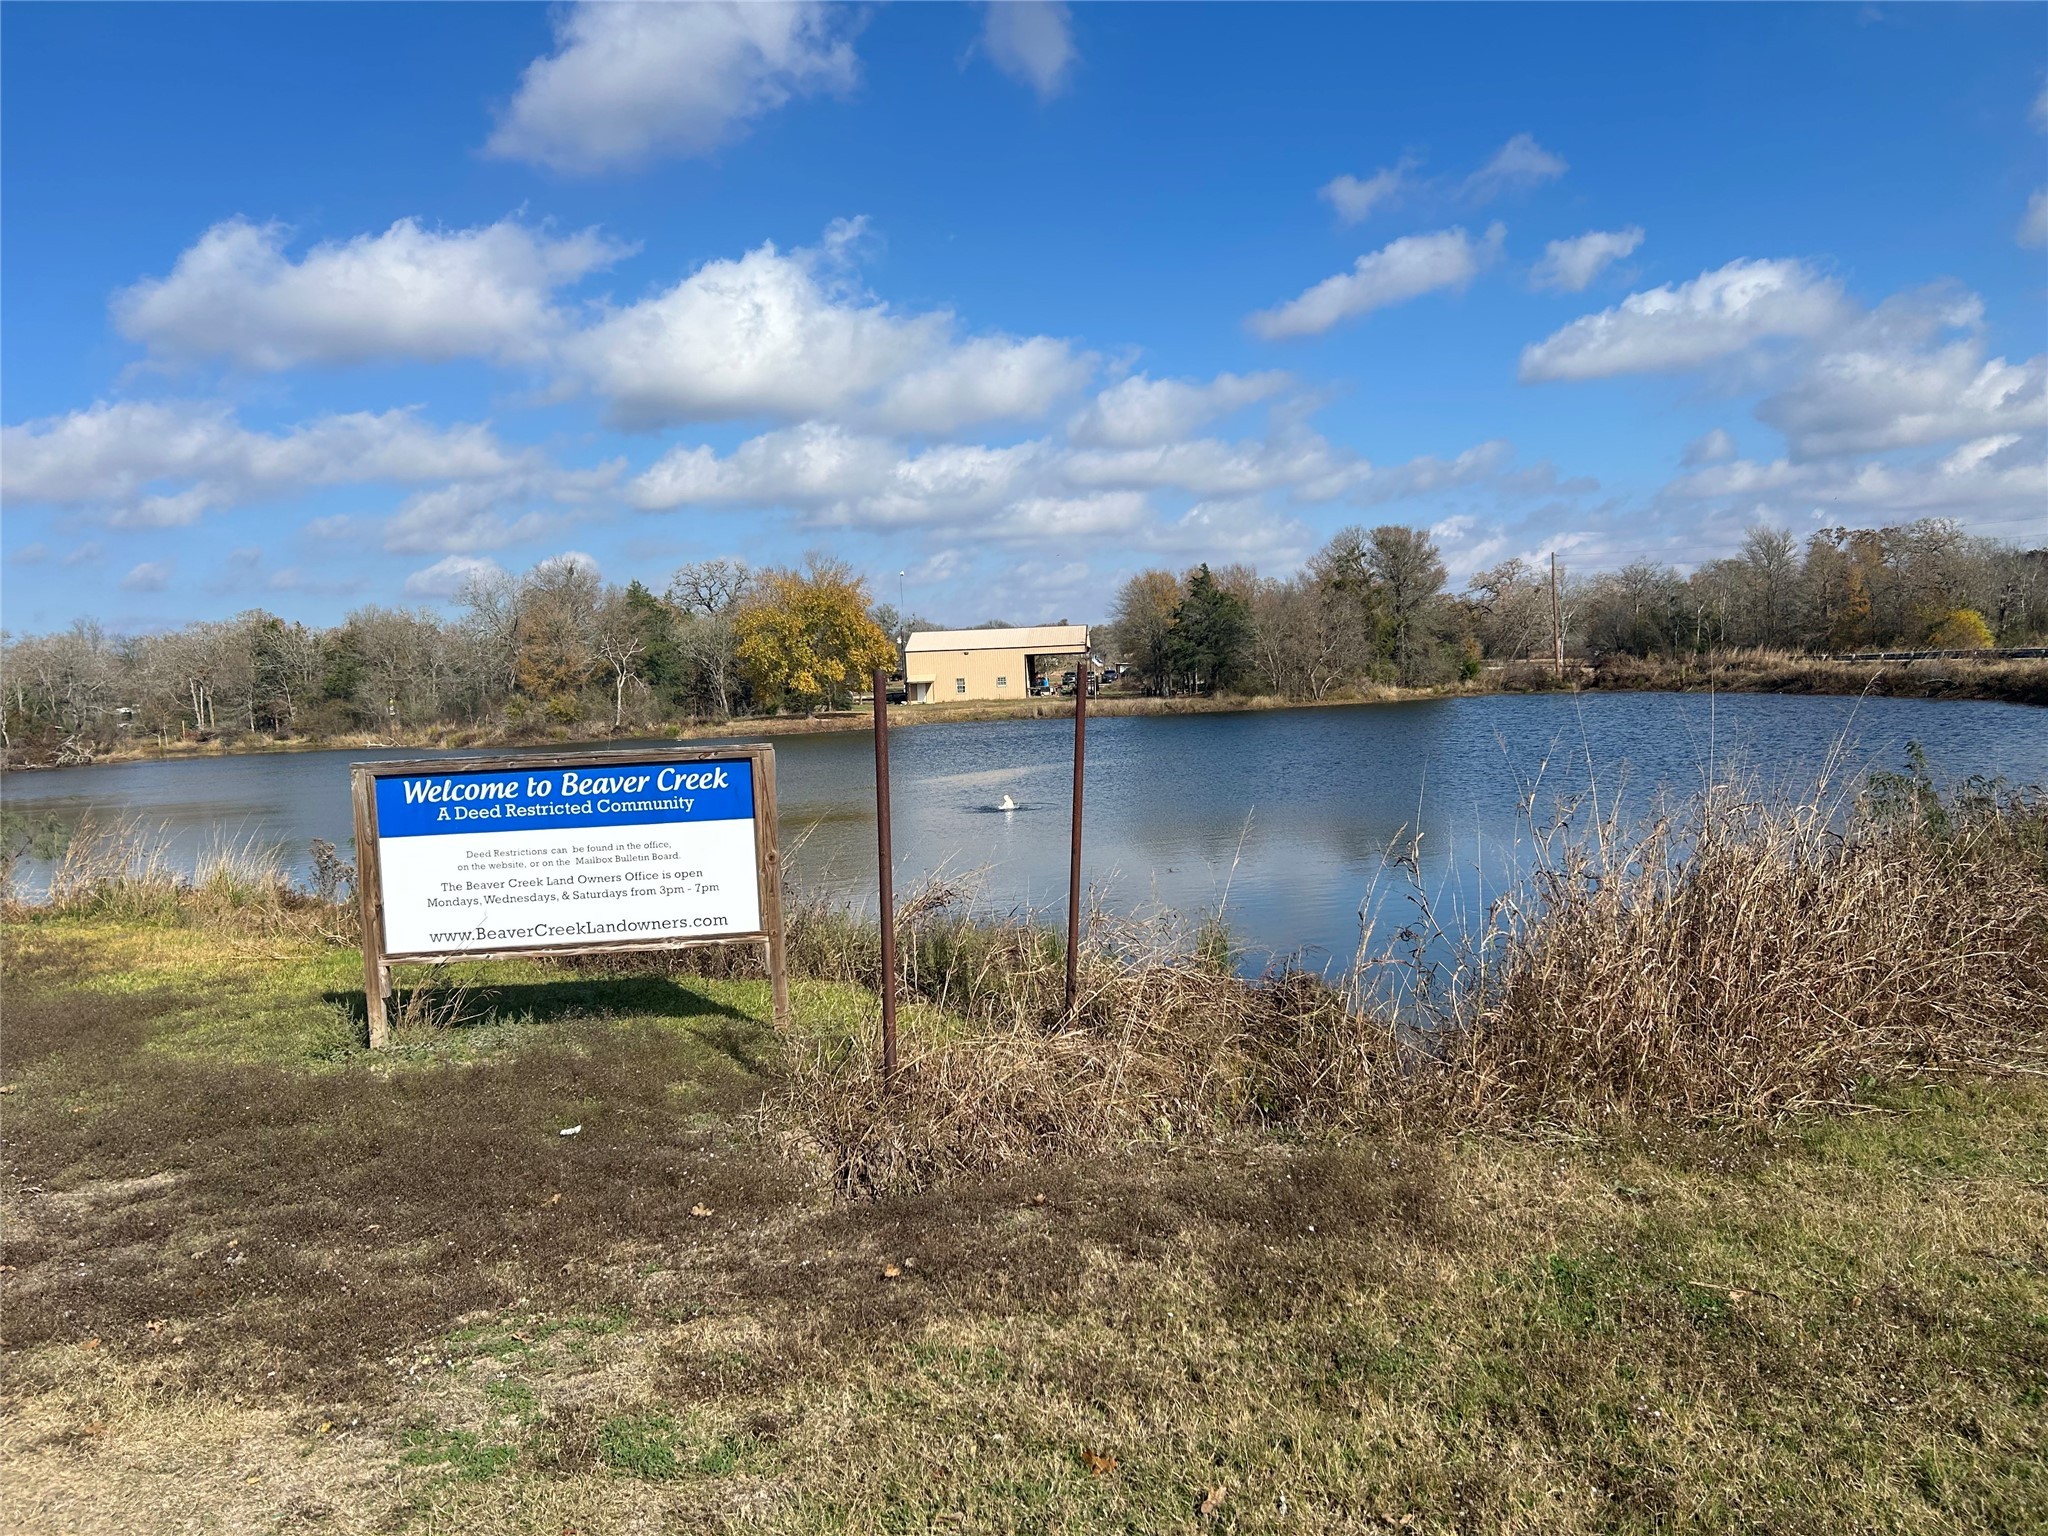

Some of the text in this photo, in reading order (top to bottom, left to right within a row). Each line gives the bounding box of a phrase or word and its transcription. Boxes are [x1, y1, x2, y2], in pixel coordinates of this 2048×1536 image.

[403, 766, 729, 804] Welcome to Beaver Creek
[436, 795, 695, 821] A Deed Restricted Community
[466, 849, 492, 859] Deed
[493, 848, 548, 858] Restrictions
[550, 847, 568, 855] can
[572, 845, 585, 853] be
[586, 843, 614, 853] found
[626, 842, 641, 850] the
[643, 840, 672, 850] office,
[471, 862, 486, 870] the
[488, 861, 527, 870] website,
[555, 858, 571, 866] the
[575, 856, 613, 865] Mailbox
[614, 854, 650, 863] Bulletin
[651, 851, 681, 861] Board.
[440, 870, 703, 892] The Beaver Creek Land Owners Office is open
[427, 896, 482, 908] Mondays,
[483, 892, 560, 905] Wednesdays,
[561, 890, 570, 901] &
[572, 889, 628, 900] Saturdays
[630, 887, 657, 897] from
[659, 885, 685, 897] 3pm
[694, 883, 720, 895] 7pm
[429, 916, 729, 943] www.BeaverCreekLandowners.com
